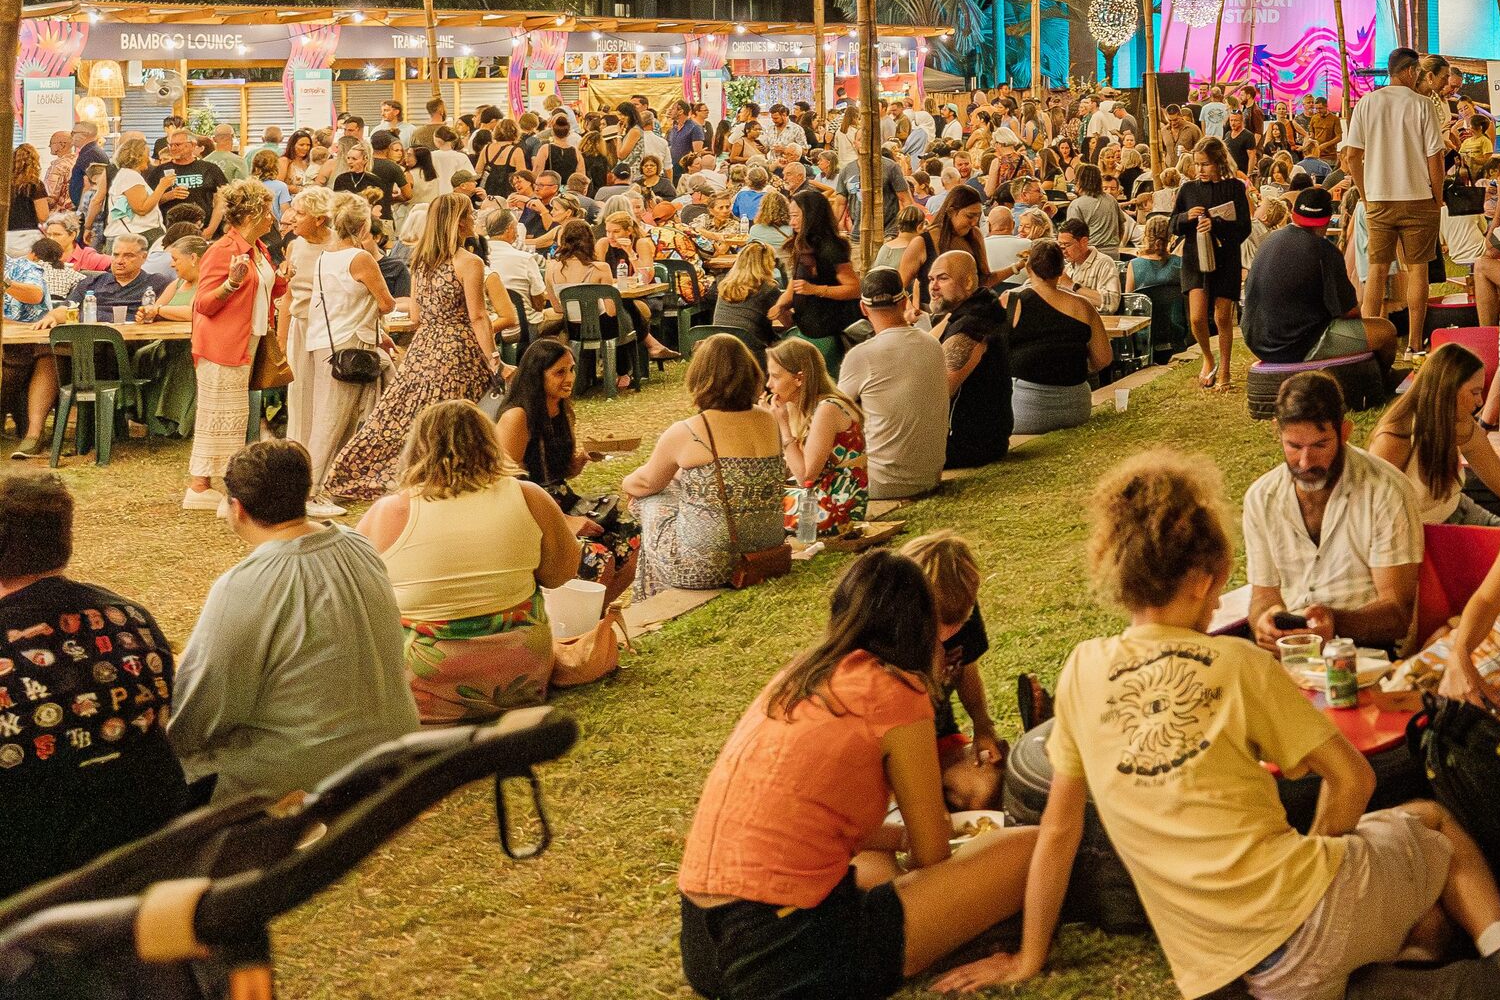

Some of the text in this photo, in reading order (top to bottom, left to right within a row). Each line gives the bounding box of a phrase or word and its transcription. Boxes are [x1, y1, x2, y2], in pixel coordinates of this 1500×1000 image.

[120, 33, 243, 50] BAMBOO LOUNGE
[392, 34, 454, 49] TRAPINE
[596, 39, 618, 52] HUGS
[40, 79, 60, 89] MENU
[37, 97, 65, 105] LOUNGE
